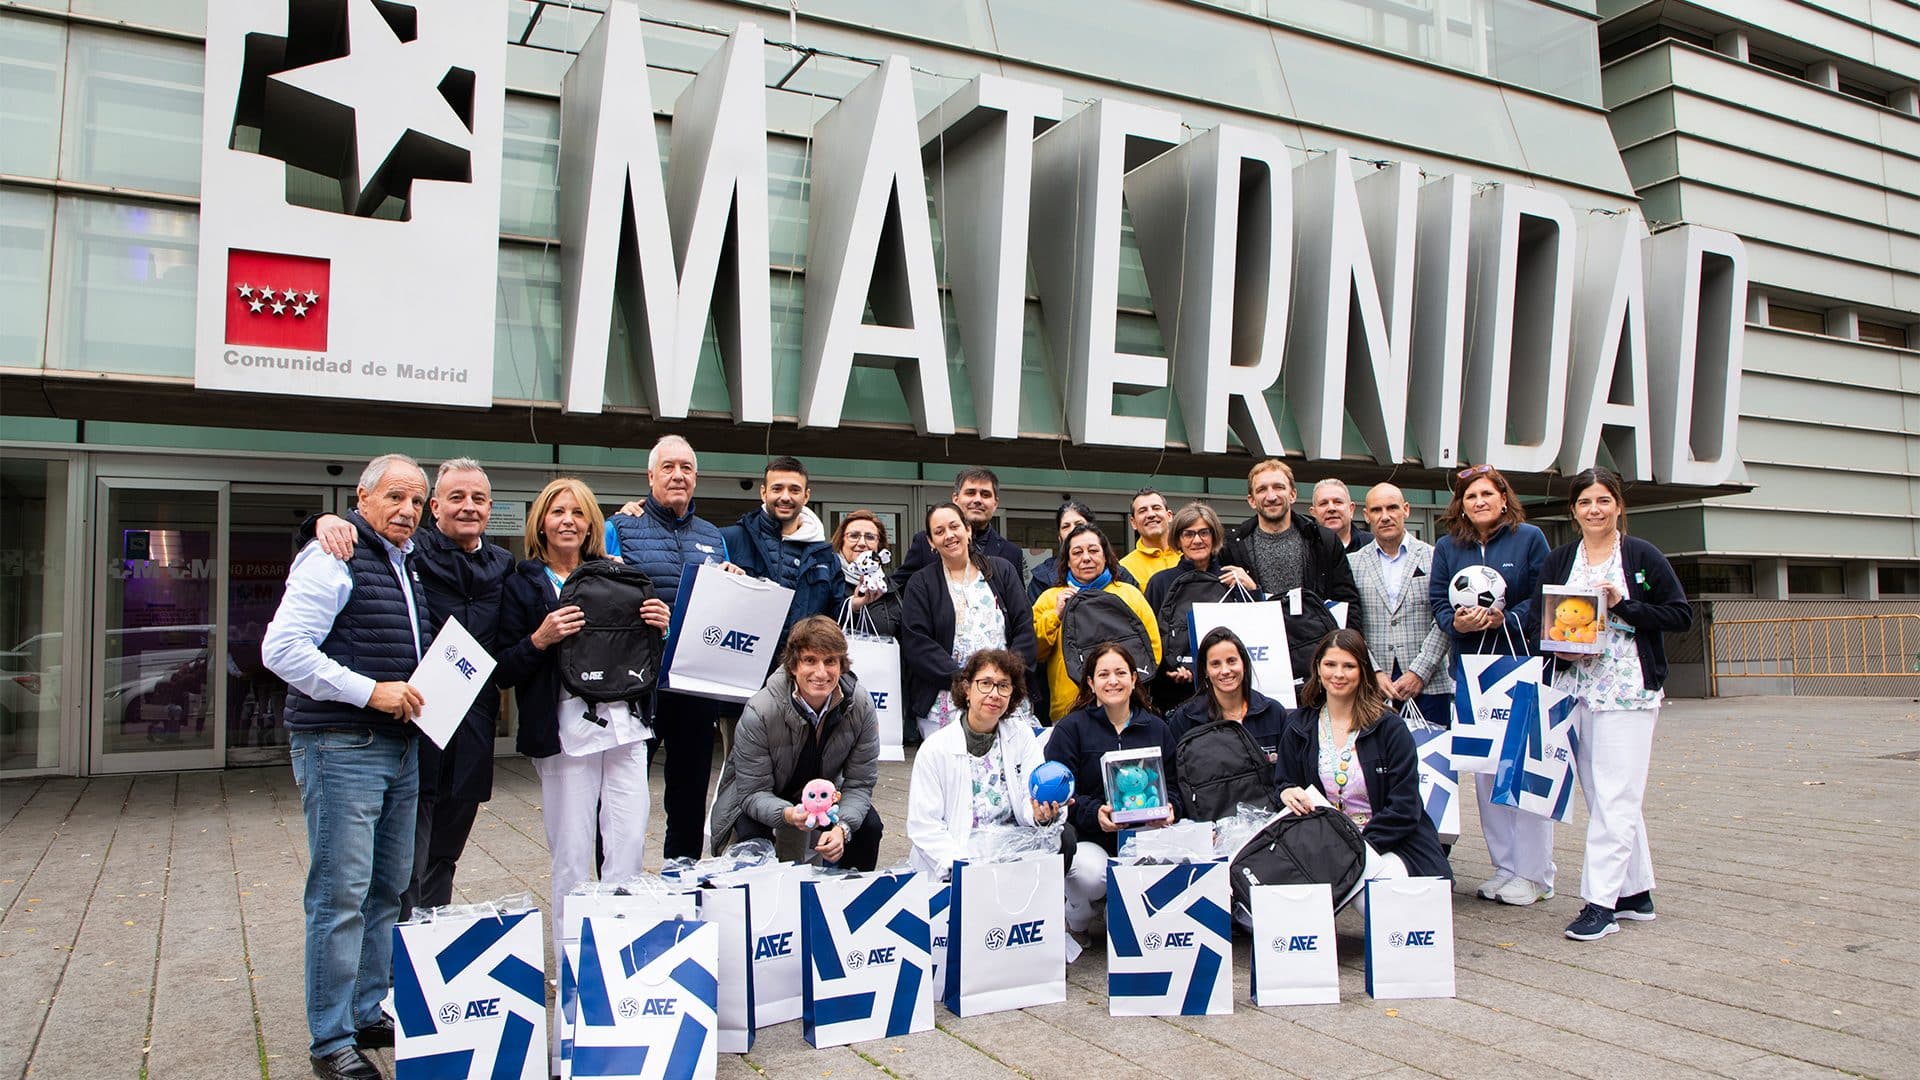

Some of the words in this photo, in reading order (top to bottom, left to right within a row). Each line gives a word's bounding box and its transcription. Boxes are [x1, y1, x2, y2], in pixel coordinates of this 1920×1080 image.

[561, 1, 1748, 485] MATERNIDAD
[224, 350, 352, 374] Comunidad
[361, 361, 387, 377] de
[396, 363, 468, 383] Madrid
[720, 630, 760, 653] AFE
[1246, 646, 1269, 661] FE
[455, 656, 478, 680] AFE
[870, 691, 889, 710] FE
[1490, 708, 1511, 721] AFE
[1554, 747, 1568, 762] AFE
[1005, 919, 1046, 947] AFE
[1164, 932, 1195, 948] AFE
[1405, 930, 1436, 946] AFE
[754, 930, 794, 961] AFE
[1288, 935, 1318, 951] AFE
[867, 946, 897, 966] AFE
[464, 997, 501, 1019] AFE
[642, 998, 678, 1016] AFE
